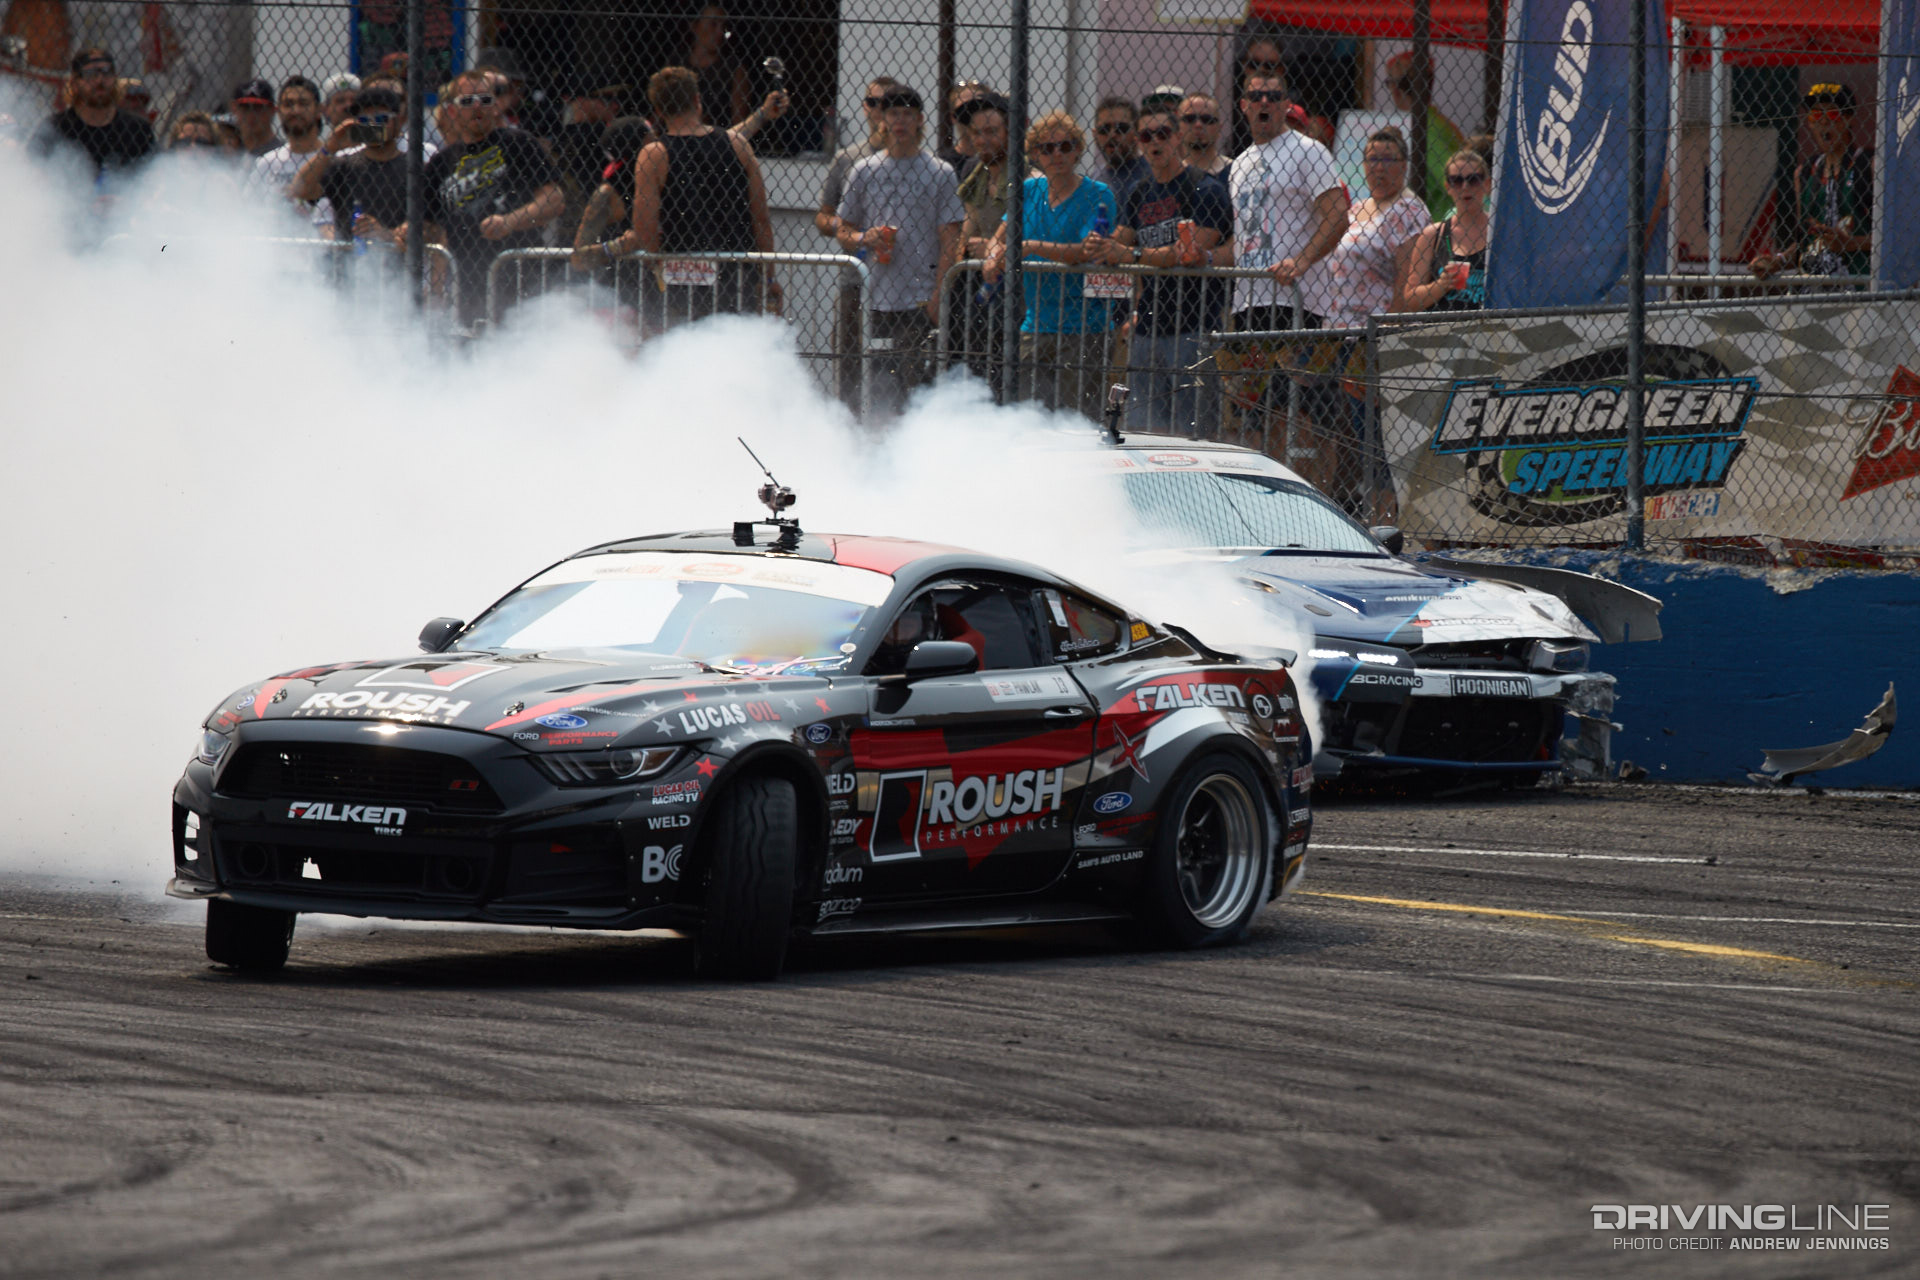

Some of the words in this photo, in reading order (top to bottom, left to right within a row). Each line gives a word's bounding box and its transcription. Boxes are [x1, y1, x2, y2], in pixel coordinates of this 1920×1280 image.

[1535, 0, 1594, 187] BUD
[1652, 492, 1720, 520] NASCAR
[300, 690, 472, 718] ROUSH
[1135, 683, 1246, 712] FALKEN
[291, 707, 454, 725] PERFORMCE
[678, 702, 747, 735] LUCAS
[749, 700, 782, 722] OIL
[513, 732, 540, 741] FORD
[651, 793, 684, 805] RACING
[685, 791, 699, 803] TV
[653, 781, 683, 797] LUCAS
[684, 779, 701, 791] OIL
[927, 766, 1064, 825] ROUSH
[287, 801, 407, 826] FALKEN
[647, 814, 691, 830] WELD
[926, 815, 1059, 843] PERFORMANCE
[1078, 822, 1097, 834] FORD
[1100, 853, 1121, 865] AUTO
[1122, 850, 1144, 861] LAND
